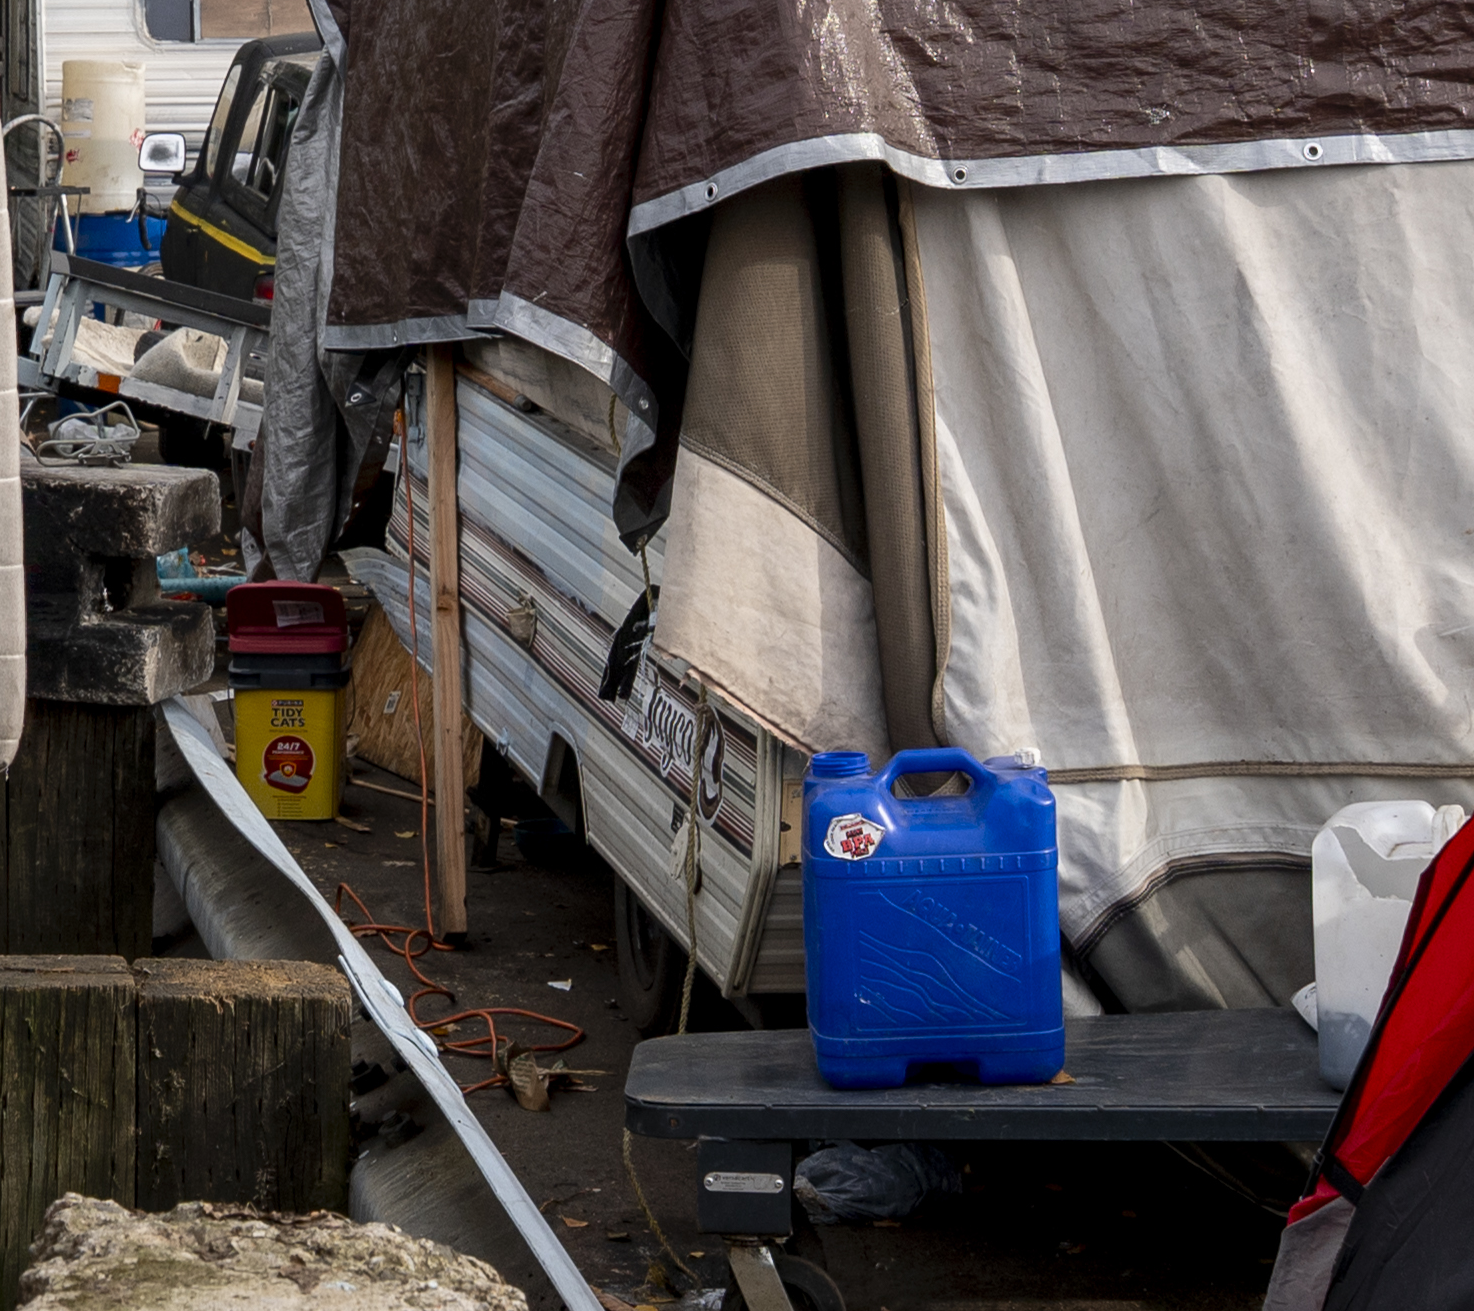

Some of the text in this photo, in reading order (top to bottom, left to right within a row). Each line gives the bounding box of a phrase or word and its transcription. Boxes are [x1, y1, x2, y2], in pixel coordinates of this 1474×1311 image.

[272, 708, 304, 717] TIDY
[270, 718, 306, 727] CATS
[643, 670, 694, 777] Jayco
[277, 742, 301, 751] 24/7
[841, 833, 875, 853] BPA
